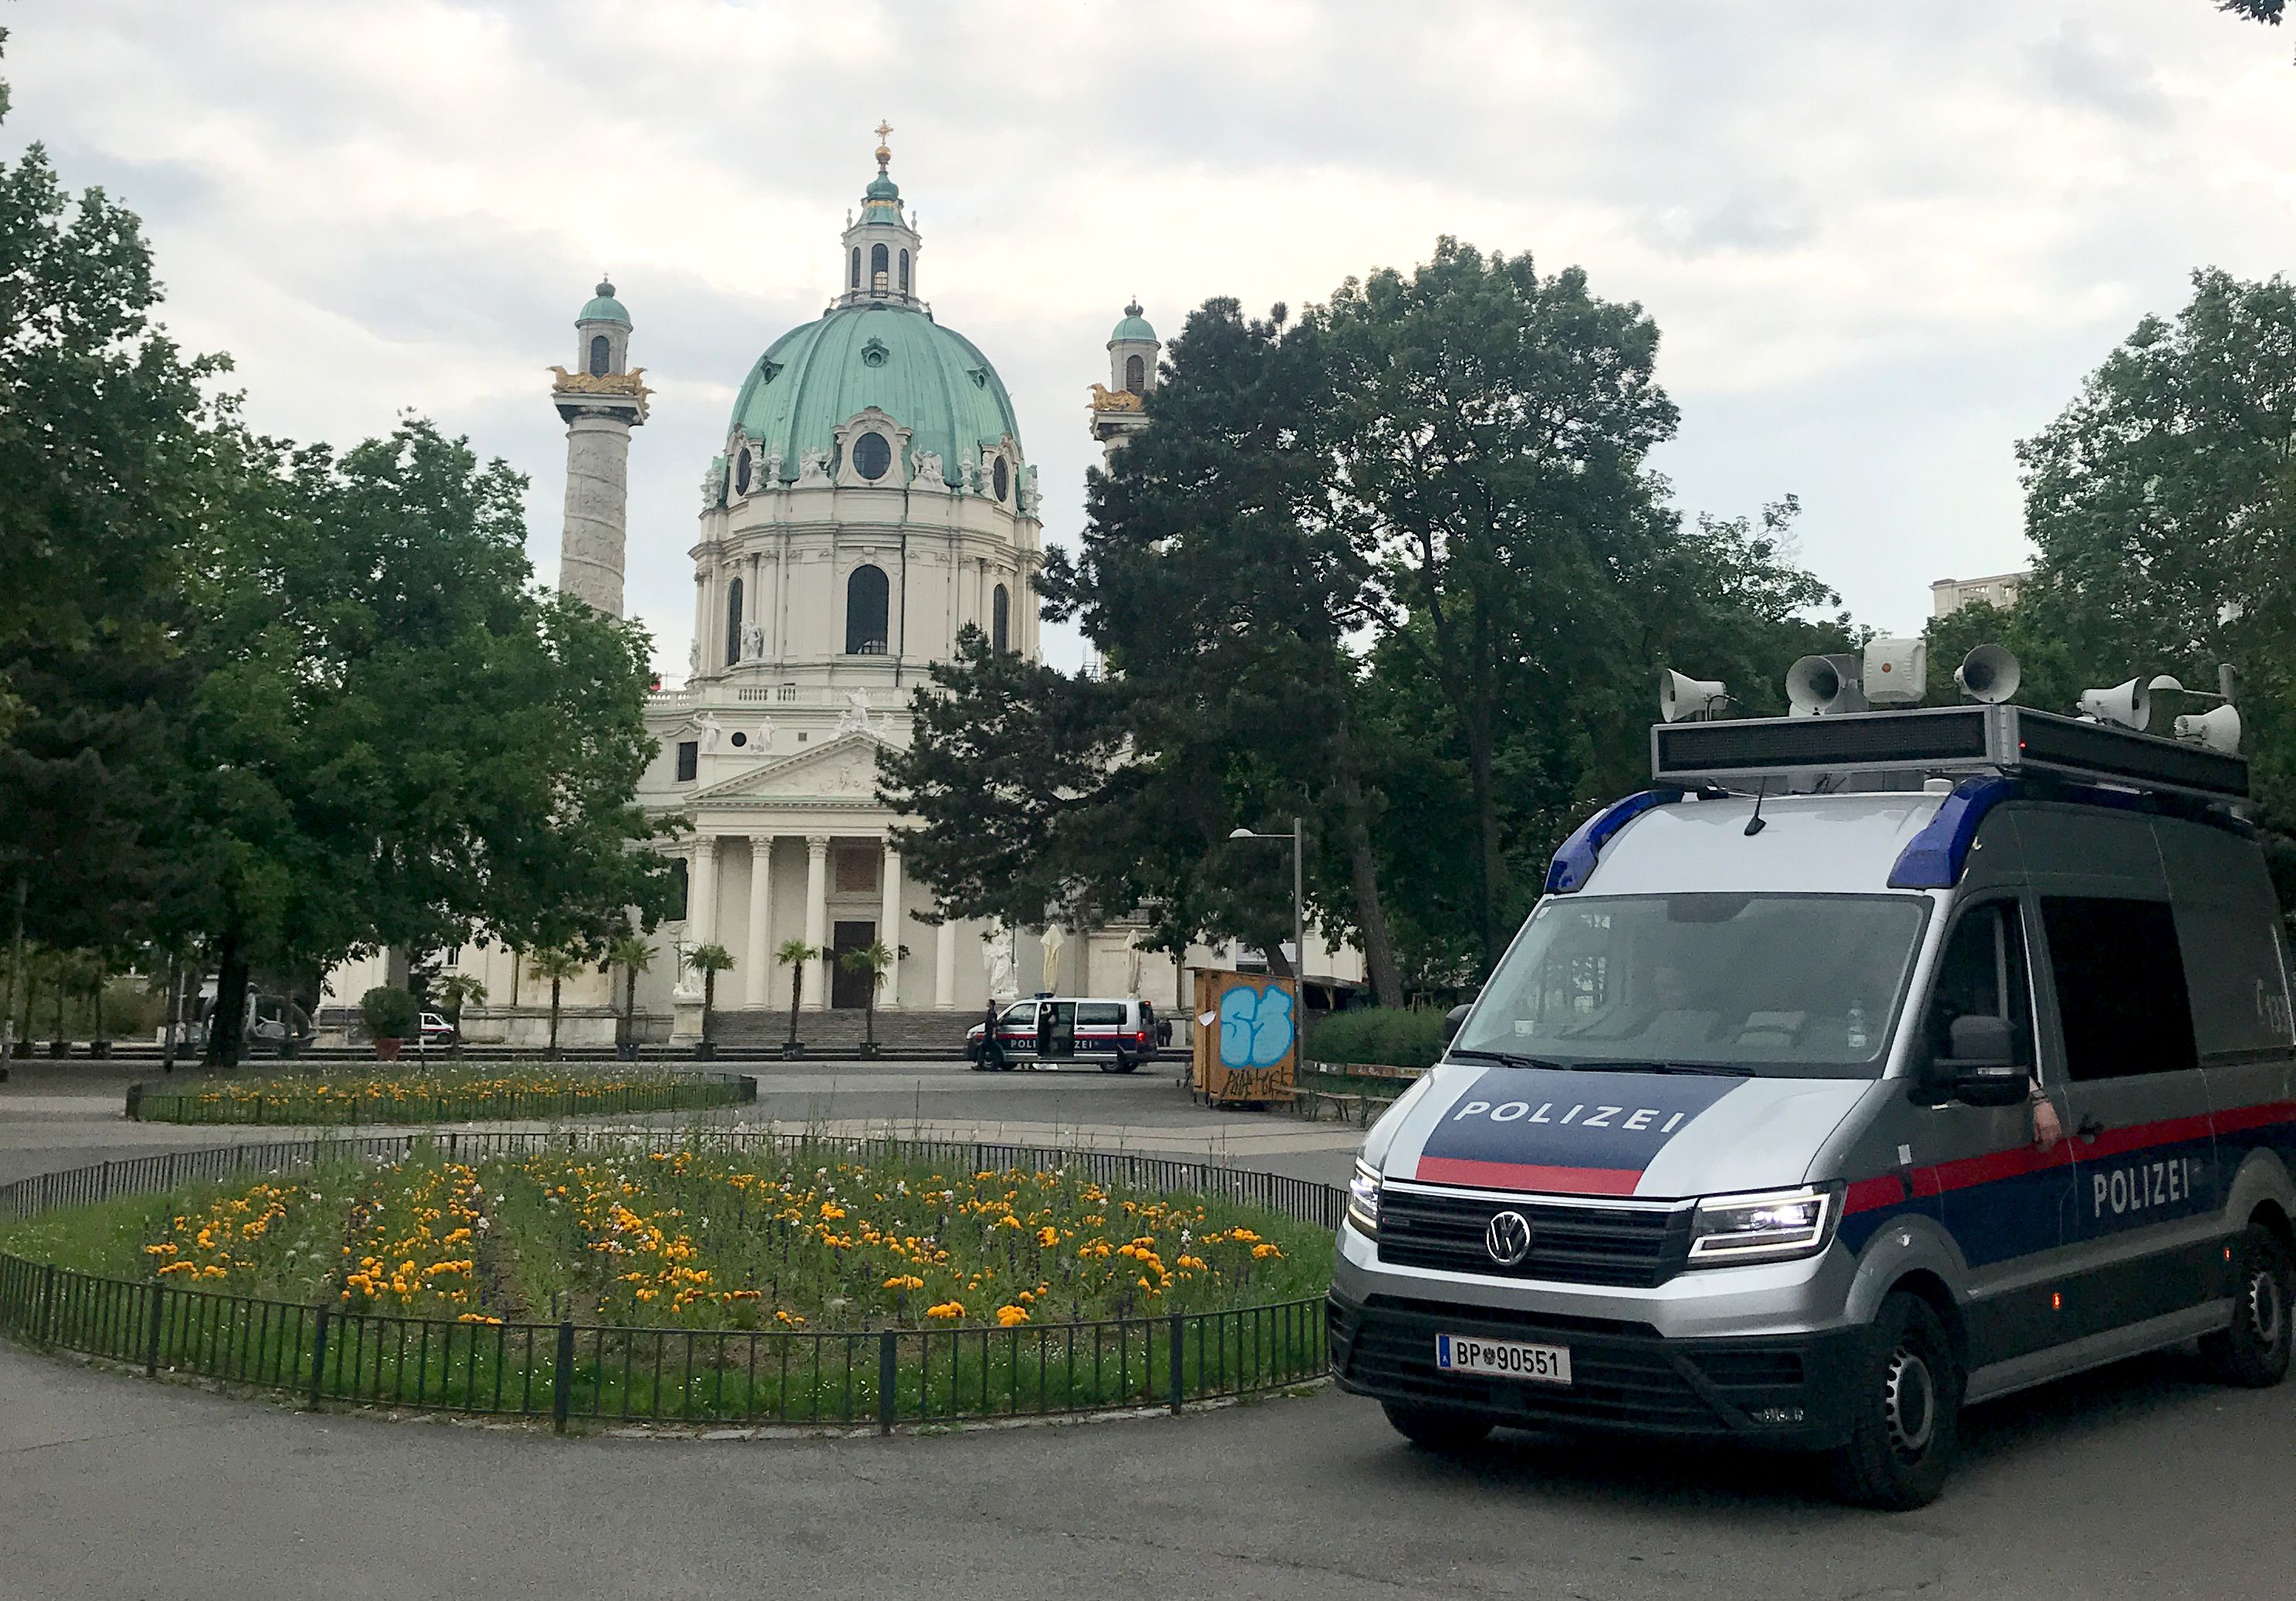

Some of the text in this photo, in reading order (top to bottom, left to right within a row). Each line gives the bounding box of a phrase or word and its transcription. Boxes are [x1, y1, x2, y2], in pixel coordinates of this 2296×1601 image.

[1453, 1101, 1685, 1133] POLIZEI
[2093, 1157, 2190, 1218] POLIZEI
[1497, 1346, 1558, 1376] 90551
